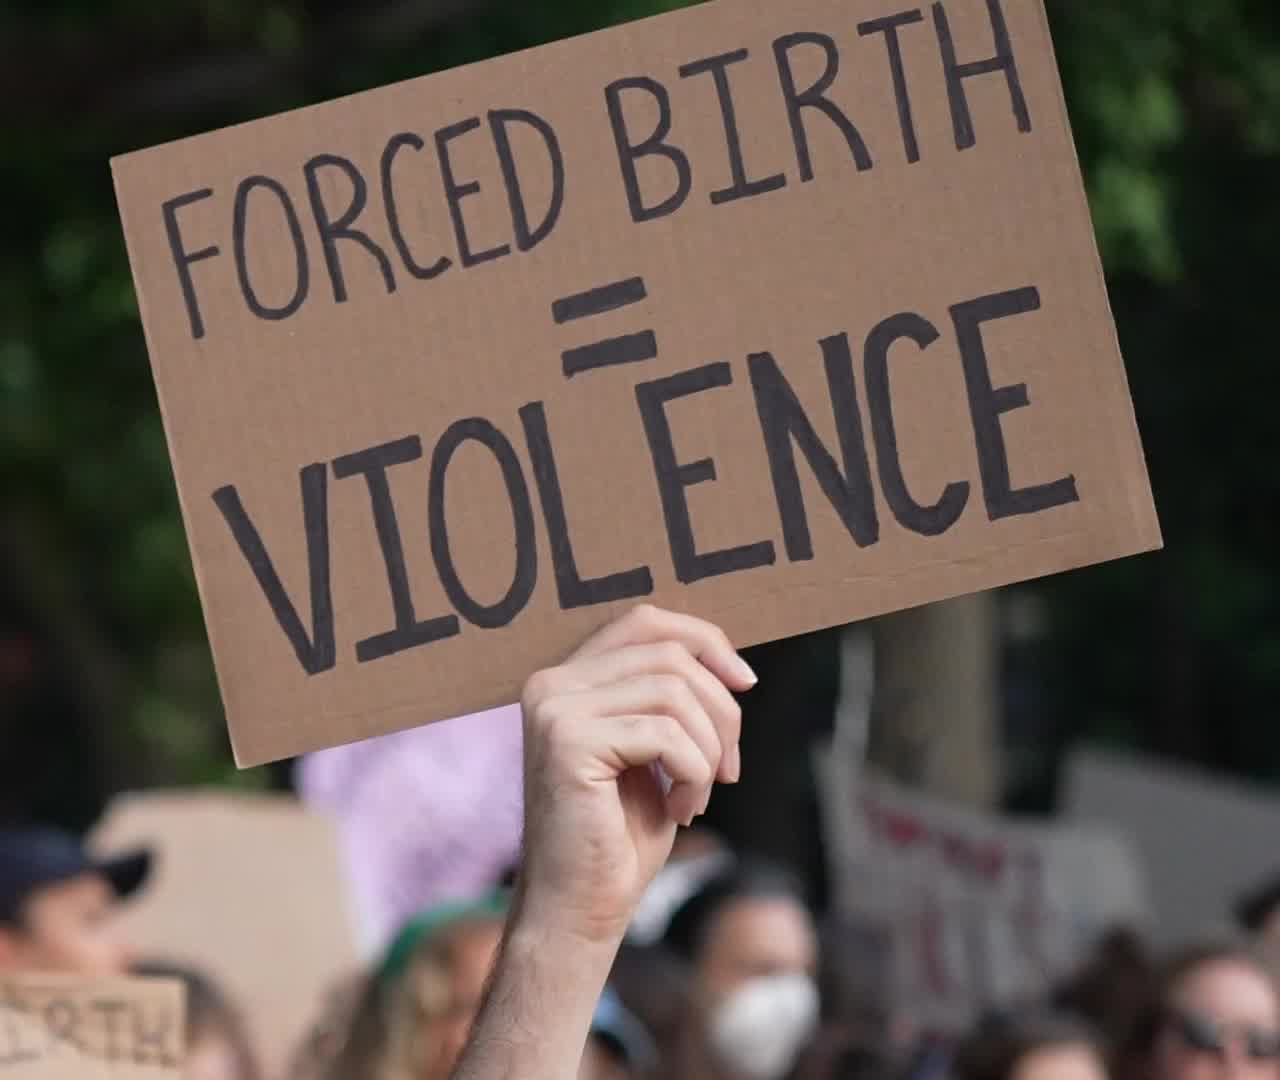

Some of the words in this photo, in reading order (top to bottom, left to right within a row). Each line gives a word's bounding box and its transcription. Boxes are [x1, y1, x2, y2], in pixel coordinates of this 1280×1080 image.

[162, 108, 564, 339] FORCED
[603, 0, 1032, 223] BIRTH
[211, 286, 1078, 675] VIOLENCE
